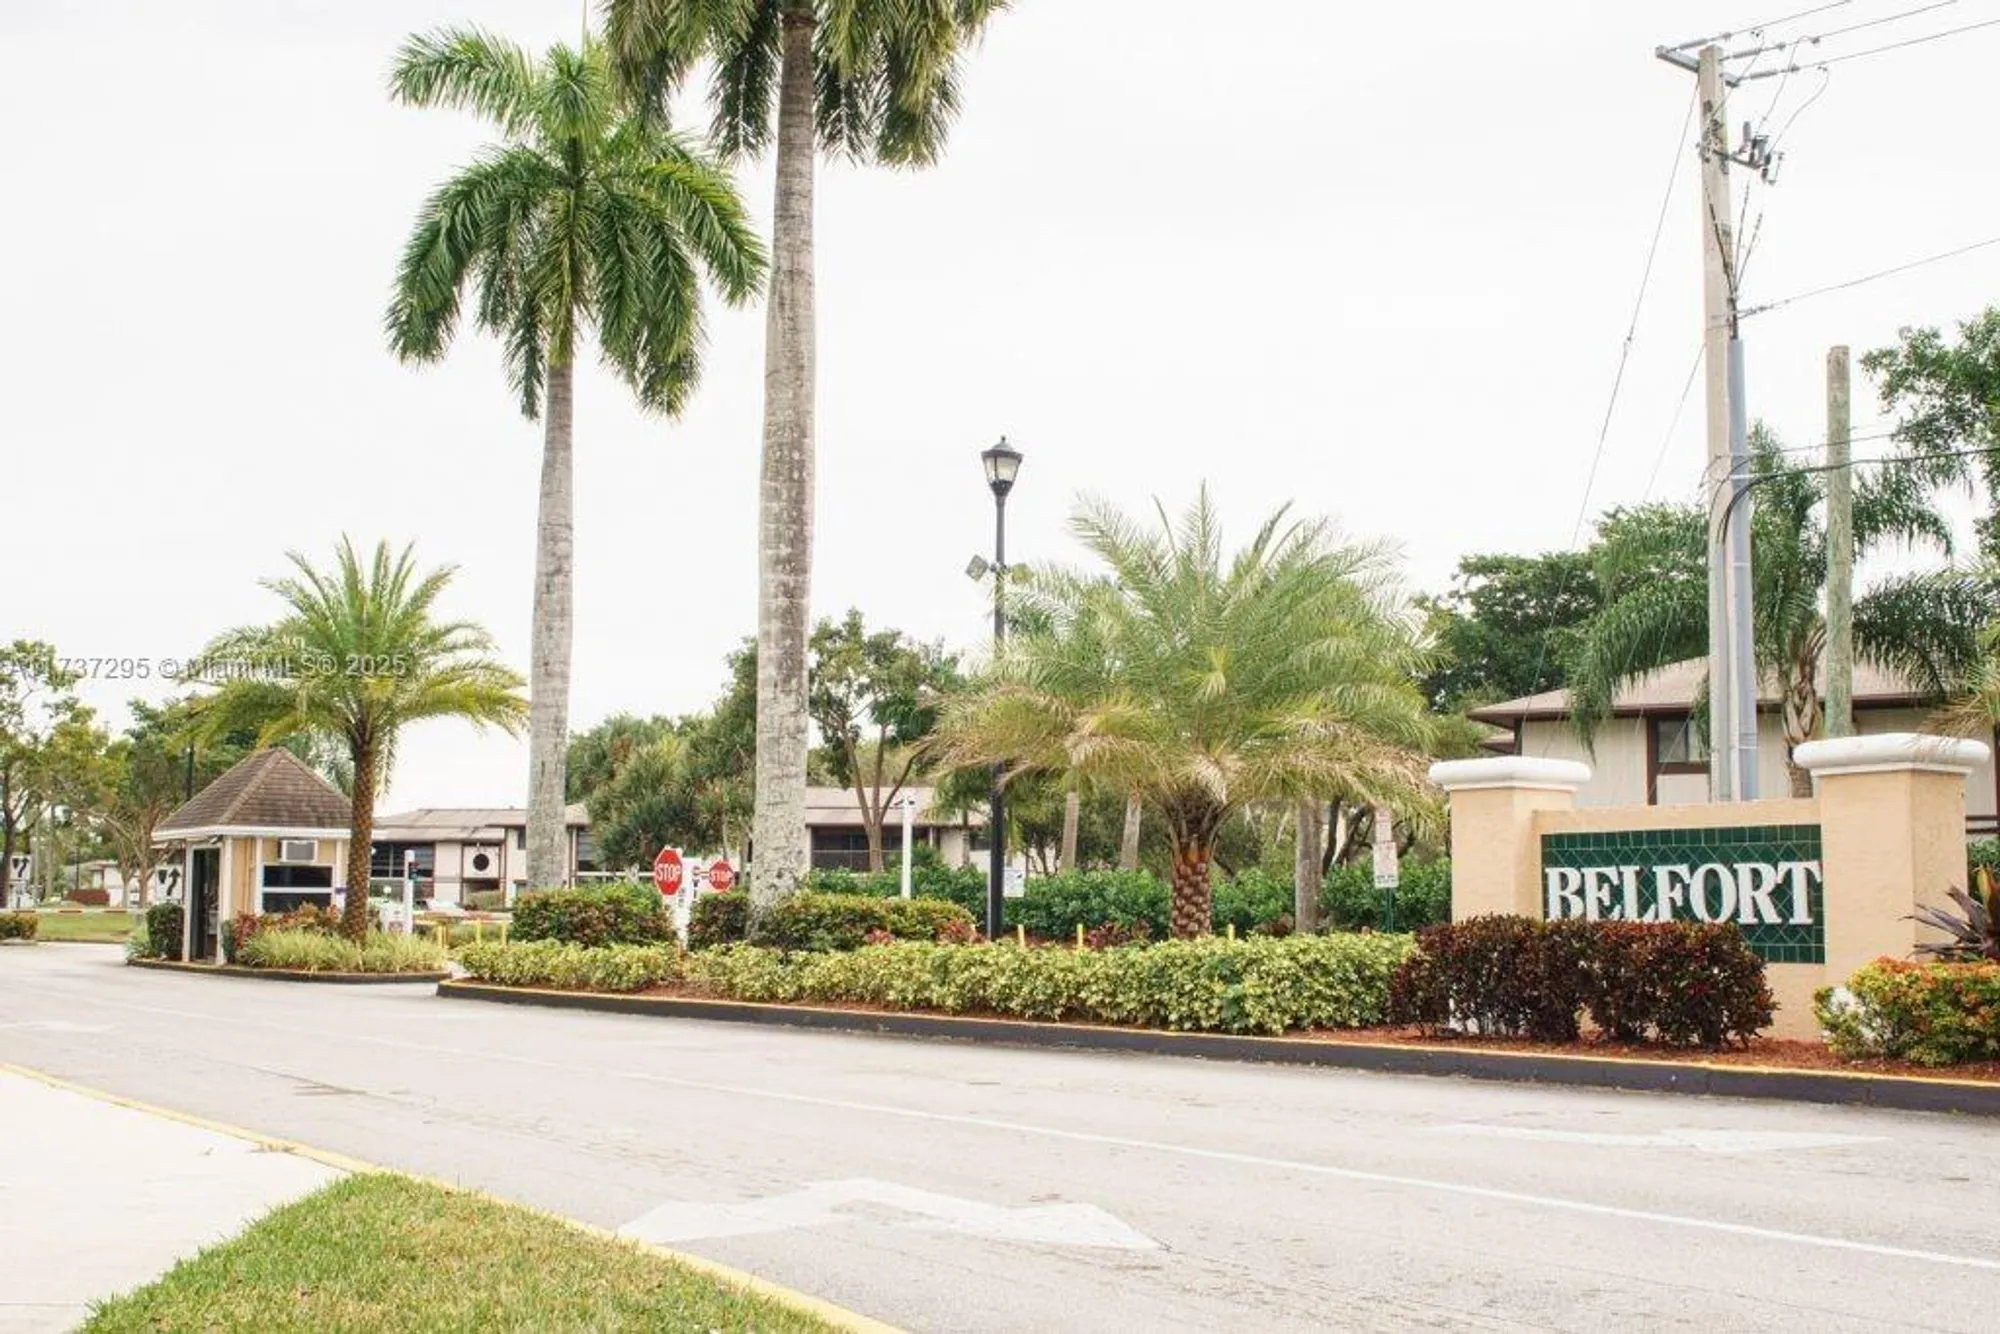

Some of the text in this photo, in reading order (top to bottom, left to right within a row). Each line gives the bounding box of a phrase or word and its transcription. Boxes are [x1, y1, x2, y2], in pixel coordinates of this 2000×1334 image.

[655, 863, 681, 882] STOP
[709, 868, 734, 882] STOP
[1544, 860, 1823, 925] BELFORT
